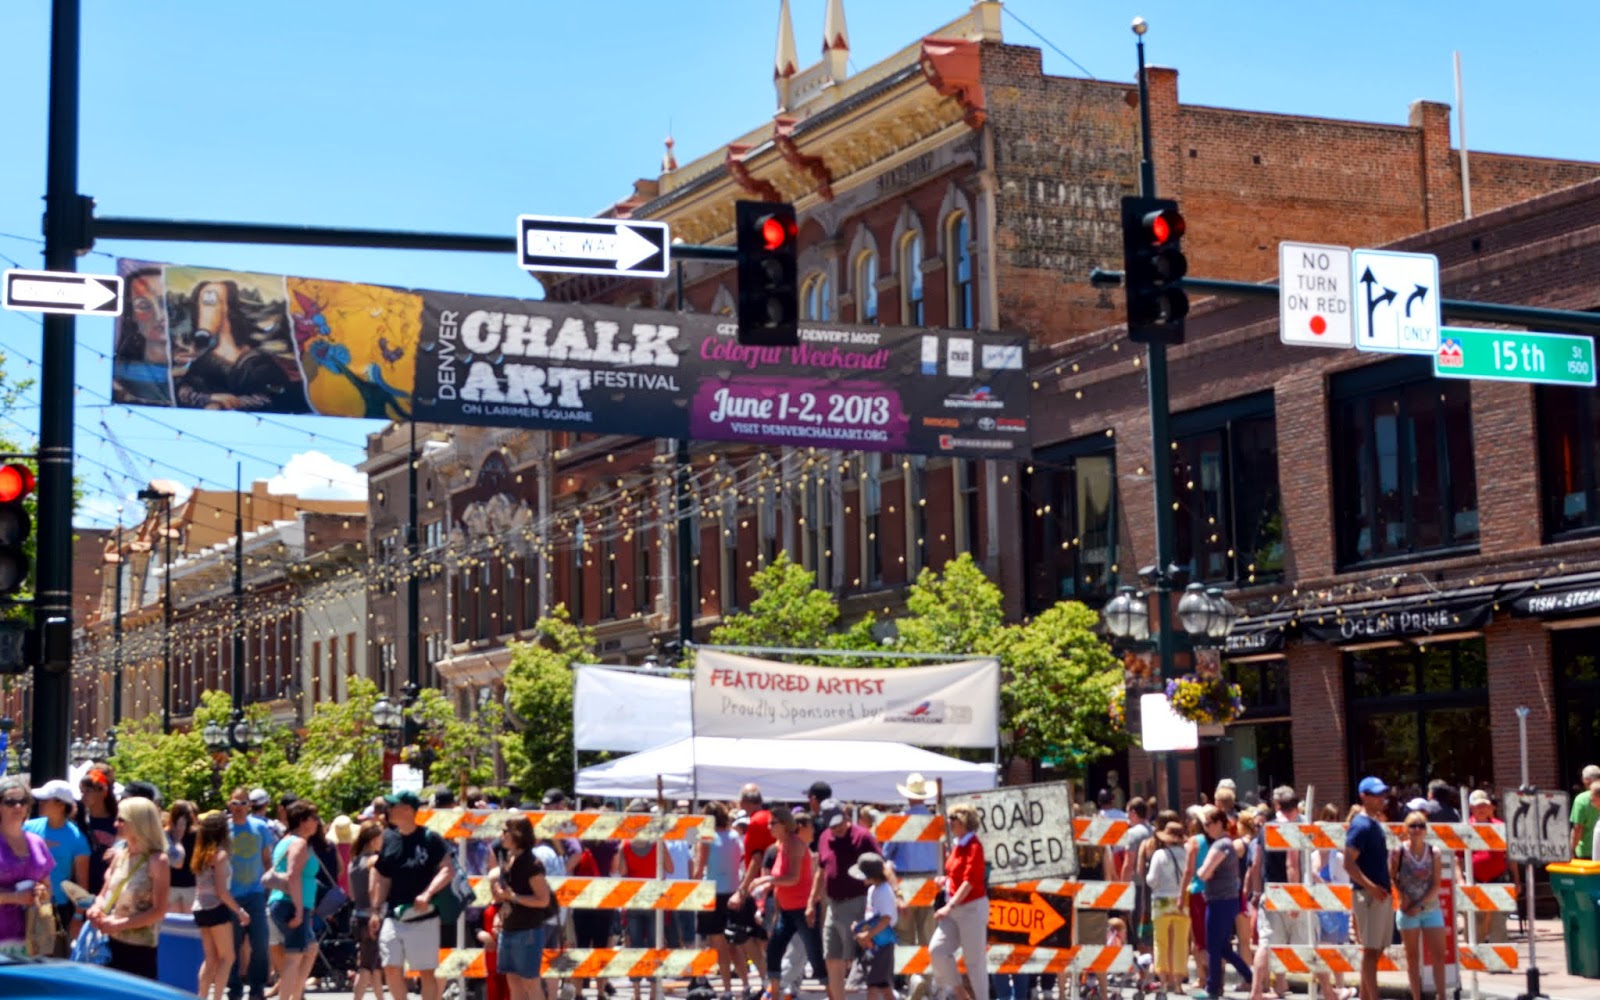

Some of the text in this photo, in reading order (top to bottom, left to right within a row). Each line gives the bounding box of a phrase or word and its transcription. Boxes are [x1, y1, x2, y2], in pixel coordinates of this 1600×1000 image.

[1302, 252, 1330, 271] NO
[1297, 274, 1338, 292] TURN
[1288, 294, 1347, 314] ON RED
[460, 310, 680, 367] CHALK
[850, 332, 881, 345] MOST
[1403, 324, 1432, 343] ONLY
[438, 310, 459, 400] DENVER
[1492, 340, 1583, 373] 15th St
[1567, 360, 1590, 375] 1500
[460, 361, 680, 408] ART FESTIVAL
[461, 404, 593, 422] ON LARIMER SQUARE
[709, 388, 890, 425] June 1-2, 2013
[731, 422, 888, 441] VISIT DENVERCHALKART.ORG
[1529, 595, 1557, 613] FISH
[1341, 610, 1449, 638] OCEAN PRIME
[710, 669, 885, 696] FEATURED ARTIST
[721, 695, 776, 724] Proudly
[780, 699, 854, 725] Sponsored
[976, 801, 1044, 833] ROAD
[991, 837, 1064, 870] OSED
[1510, 842, 1536, 858] ONLY
[1538, 844, 1568, 859] ONLY
[989, 904, 1046, 931] ETOUR
